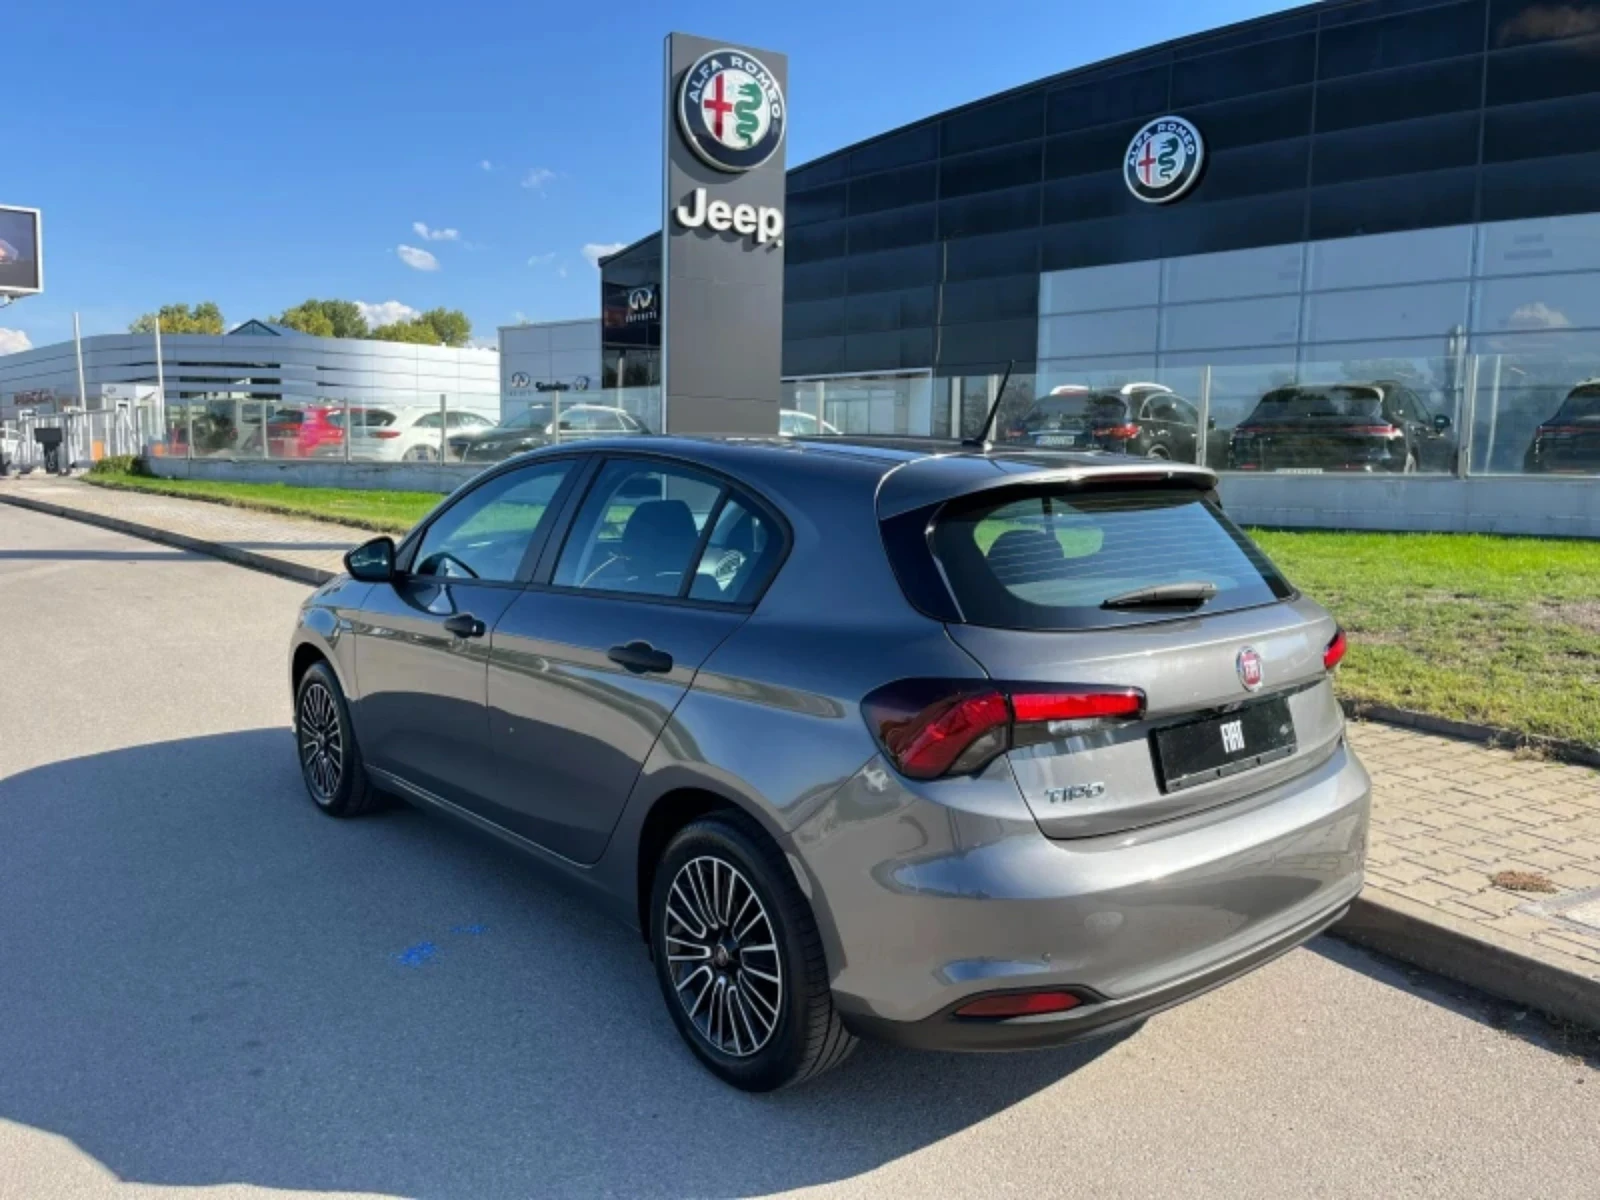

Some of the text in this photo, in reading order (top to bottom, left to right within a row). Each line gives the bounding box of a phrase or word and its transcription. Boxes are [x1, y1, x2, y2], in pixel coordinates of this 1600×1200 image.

[688, 55, 781, 119] ALFA ROMEO
[1128, 123, 1195, 167] ALFA ROMEO
[677, 187, 785, 244] Jeep
[1220, 720, 1245, 754] FIAT
